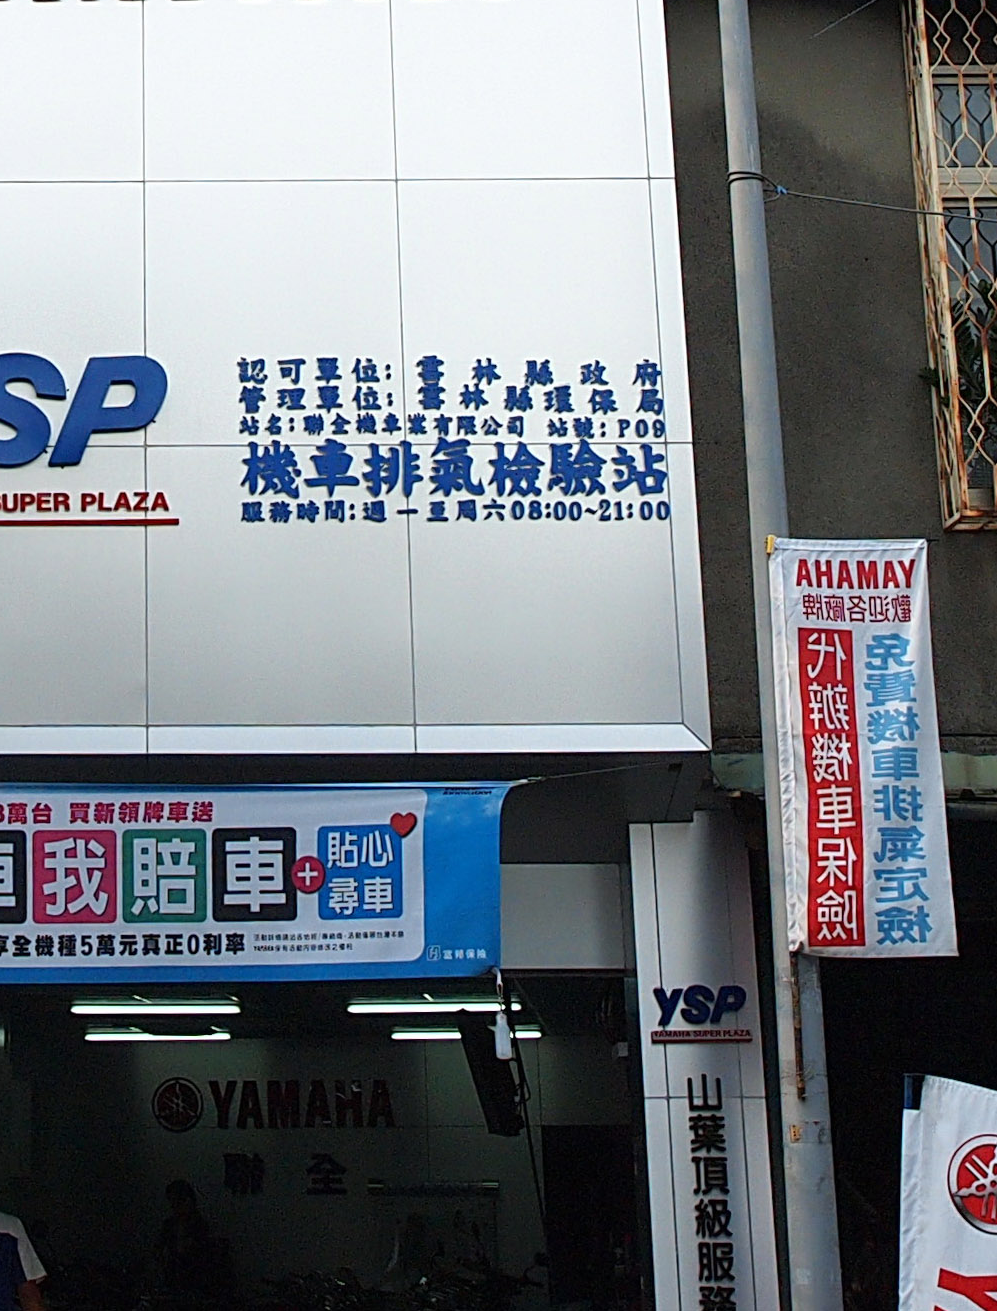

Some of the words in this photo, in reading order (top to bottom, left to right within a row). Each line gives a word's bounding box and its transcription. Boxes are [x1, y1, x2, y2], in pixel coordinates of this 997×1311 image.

[240, 438, 668, 499] 機車排氣檢驗站
[81, 492, 170, 512] PLAZA
[69, 800, 214, 824] 買新領牌車送
[326, 830, 394, 869] 貼心
[327, 876, 394, 916] 尋車
[653, 984, 747, 1027] YSP
[207, 1079, 397, 1129] YAMAHA
